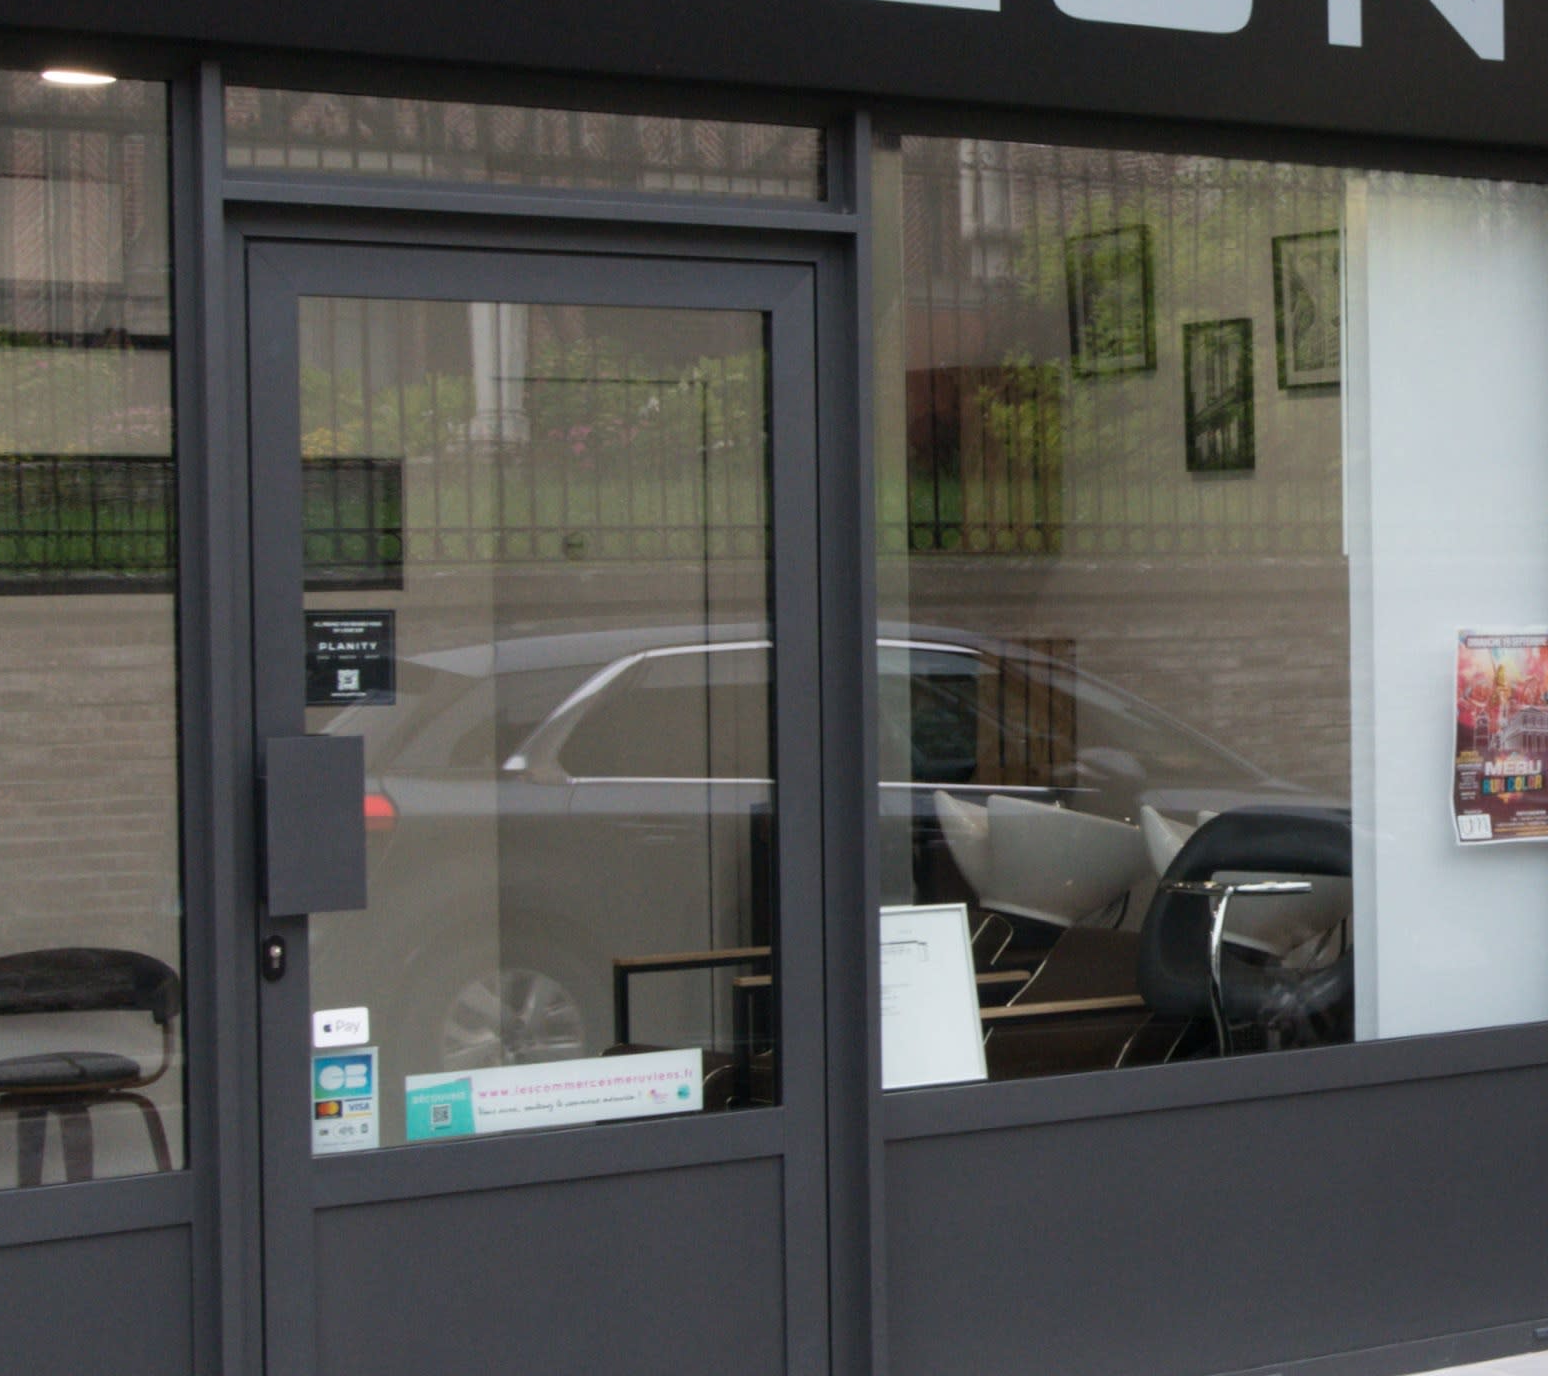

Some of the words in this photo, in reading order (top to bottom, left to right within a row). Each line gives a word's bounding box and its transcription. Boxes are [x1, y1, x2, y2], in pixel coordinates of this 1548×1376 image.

[318, 641, 378, 651] PLANITY
[335, 1019, 360, 1034] Pay
[348, 1102, 370, 1111] VISA
